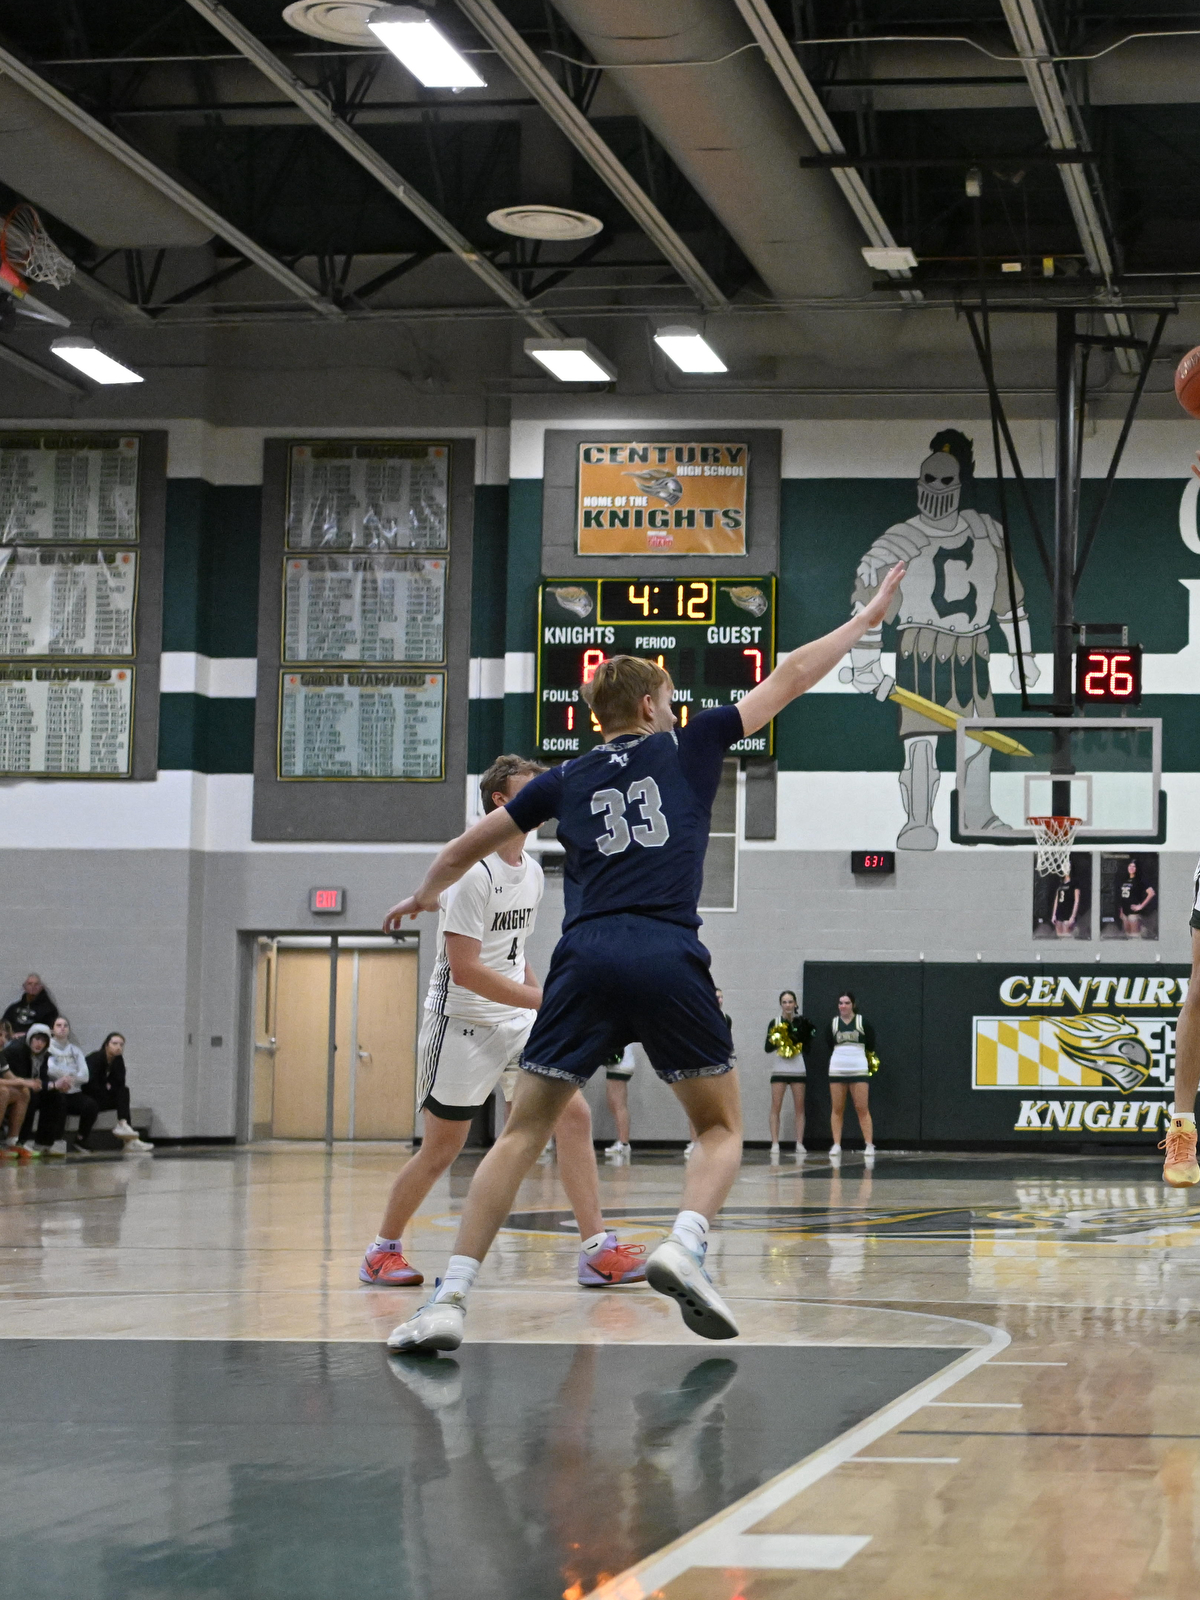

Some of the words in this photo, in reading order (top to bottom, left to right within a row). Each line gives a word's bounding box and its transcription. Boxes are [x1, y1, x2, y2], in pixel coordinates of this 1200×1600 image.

[582, 446, 745, 465] CENTURY
[676, 465, 702, 477] HIGH
[704, 465, 744, 477] SCHOOL
[583, 496, 613, 507] HOME
[614, 496, 627, 507] OF
[629, 495, 648, 507] THE
[583, 508, 743, 529] KNIGHTS
[628, 582, 709, 619] 4:12
[544, 626, 615, 644] KNIGHTS
[707, 626, 762, 644] GUEST
[635, 636, 676, 649] PERIOD
[743, 649, 762, 683] 7
[1085, 654, 1133, 695] 26
[347, 674, 426, 687] CHAMPIONS
[543, 689, 579, 702] FOULS
[672, 689, 693, 702] OUL
[567, 705, 574, 731] 1
[542, 738, 579, 751] SCORE
[590, 775, 670, 857] 33
[316, 890, 338, 908] EXIT
[490, 907, 534, 932] KNIGHT
[507, 937, 518, 966] 4
